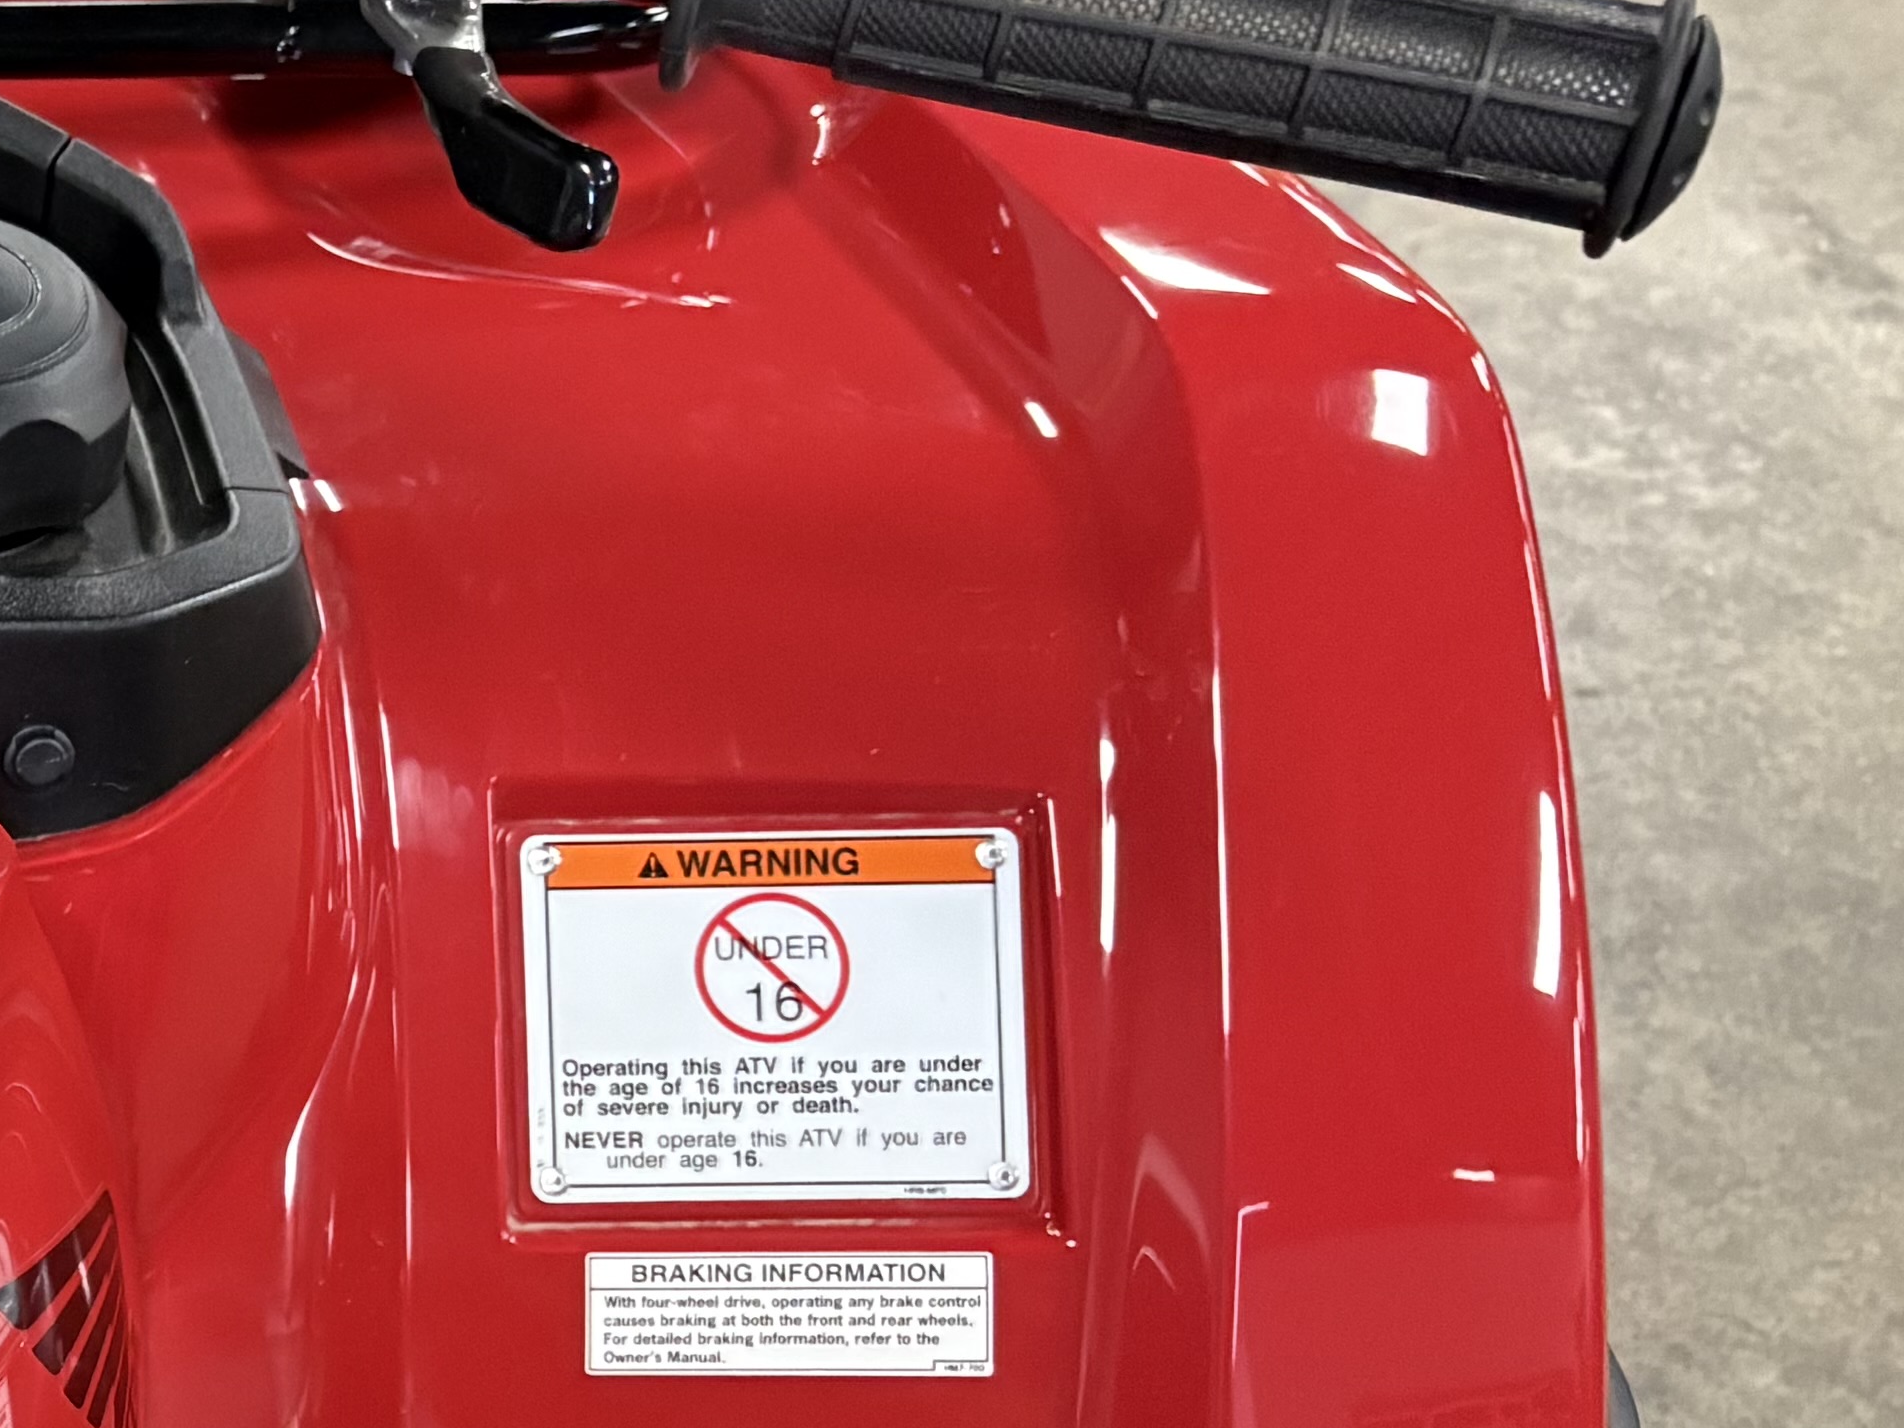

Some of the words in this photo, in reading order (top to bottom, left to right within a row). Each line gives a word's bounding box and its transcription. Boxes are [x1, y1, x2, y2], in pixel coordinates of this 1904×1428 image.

[676, 847, 860, 878] WARNING
[713, 935, 830, 962] UNDER
[745, 981, 804, 1023] 16
[561, 1058, 669, 1080] Operating
[681, 1057, 723, 1075] this
[733, 1057, 778, 1075] ATV
[790, 1057, 806, 1074] if
[816, 1061, 858, 1078] you
[870, 1060, 907, 1074] are
[918, 1055, 983, 1073] under
[562, 1078, 597, 1096] the
[608, 1082, 649, 1099] age
[660, 1078, 687, 1095] of
[695, 1077, 720, 1095] 16
[733, 1076, 839, 1094] increases
[851, 1080, 902, 1097] your
[913, 1075, 995, 1093] chance
[562, 1098, 585, 1116] of
[596, 1102, 670, 1116] severe
[681, 1097, 744, 1119] injury
[756, 1101, 780, 1114] or
[791, 1096, 860, 1114] death.
[564, 1131, 644, 1149] NEVER
[656, 1131, 737, 1151] operate
[749, 1130, 788, 1147] this
[798, 1130, 844, 1147] ATV
[855, 1129, 869, 1146] if
[880, 1133, 919, 1150] you
[932, 1132, 968, 1146] are
[606, 1150, 667, 1168] under
[679, 1155, 719, 1171] age
[732, 1150, 764, 1168] 16.
[631, 1263, 753, 1283] BRAKING
[762, 1262, 946, 1282] INFORMATION
[604, 1295, 637, 1309] With
[723, 1295, 766, 1311] drive,
[771, 1295, 843, 1311] operating
[848, 1298, 875, 1311] any
[879, 1294, 924, 1308] brake
[928, 1294, 982, 1308] control
[603, 1317, 656, 1327] causes
[660, 1314, 717, 1330] braking
[721, 1314, 737, 1327] at
[741, 1314, 774, 1327] both
[778, 1313, 803, 1327] the
[807, 1313, 844, 1327] front
[848, 1313, 876, 1327] and
[880, 1316, 913, 1327] rear
[917, 1313, 973, 1327] wheels.
[603, 1332, 628, 1345] For
[632, 1332, 693, 1345] detailed
[697, 1332, 754, 1348] braking
[759, 1332, 850, 1348] information,
[854, 1332, 892, 1345] refer
[896, 1332, 912, 1345] to
[916, 1332, 940, 1345] the
[603, 1351, 662, 1364] Owner's
[667, 1351, 726, 1364] Manual.
